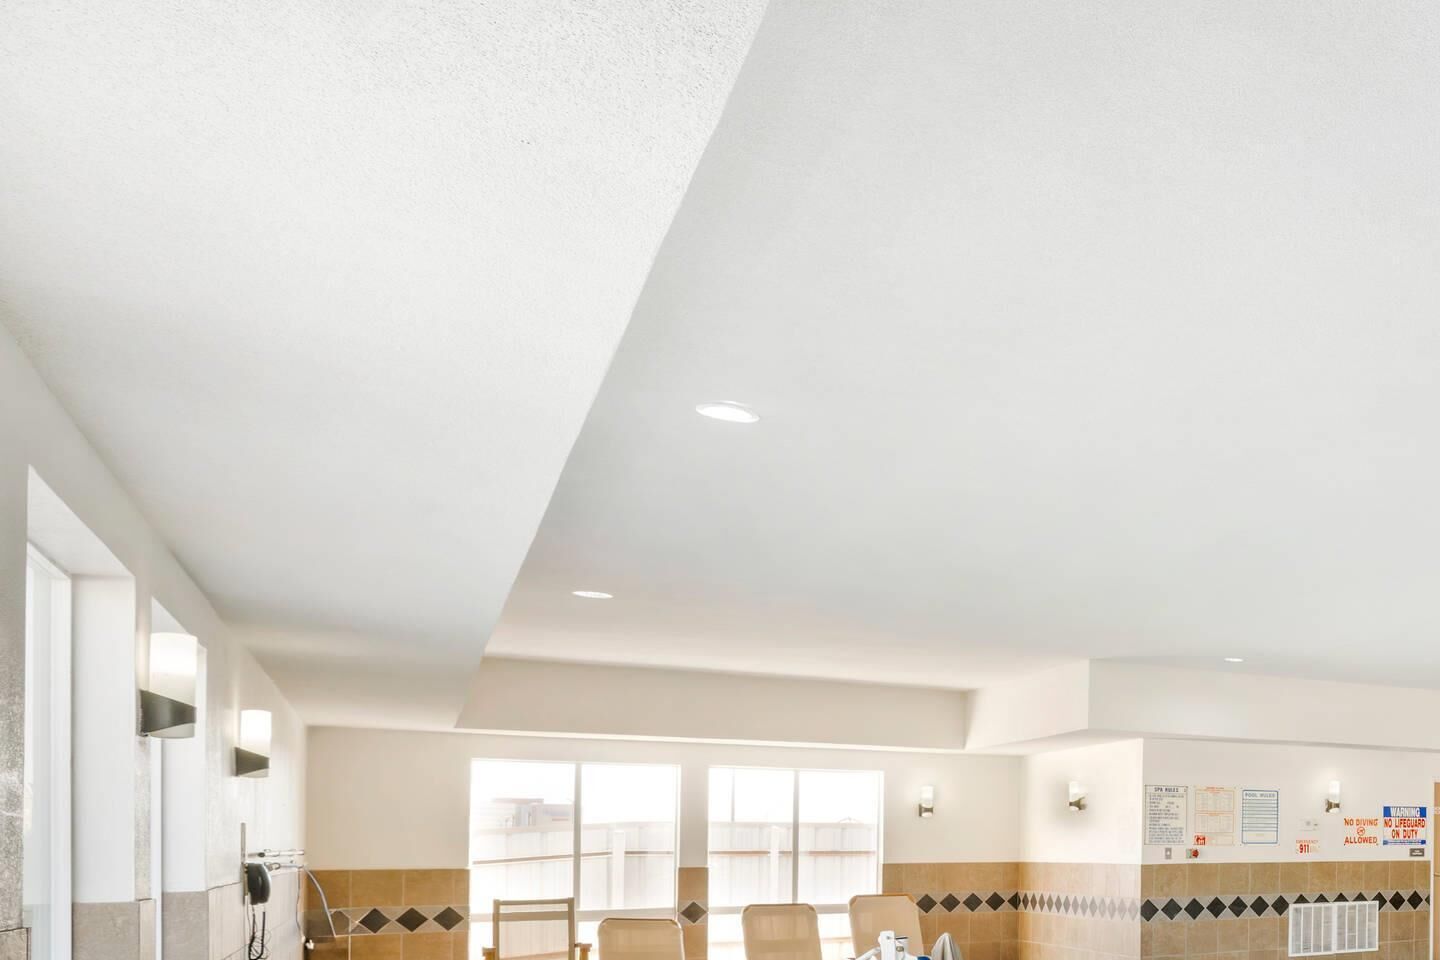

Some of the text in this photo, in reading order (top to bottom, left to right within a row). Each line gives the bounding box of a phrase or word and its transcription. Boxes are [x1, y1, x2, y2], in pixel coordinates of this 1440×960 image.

[1390, 807, 1420, 817] WARNING
[1344, 818, 1378, 826] NO DIVING
[1384, 818, 1426, 828] NO LIFEGUARD
[1391, 829, 1418, 838] ON DUTY
[1344, 836, 1378, 844] ALLOWED
[1299, 844, 1309, 854] 911
